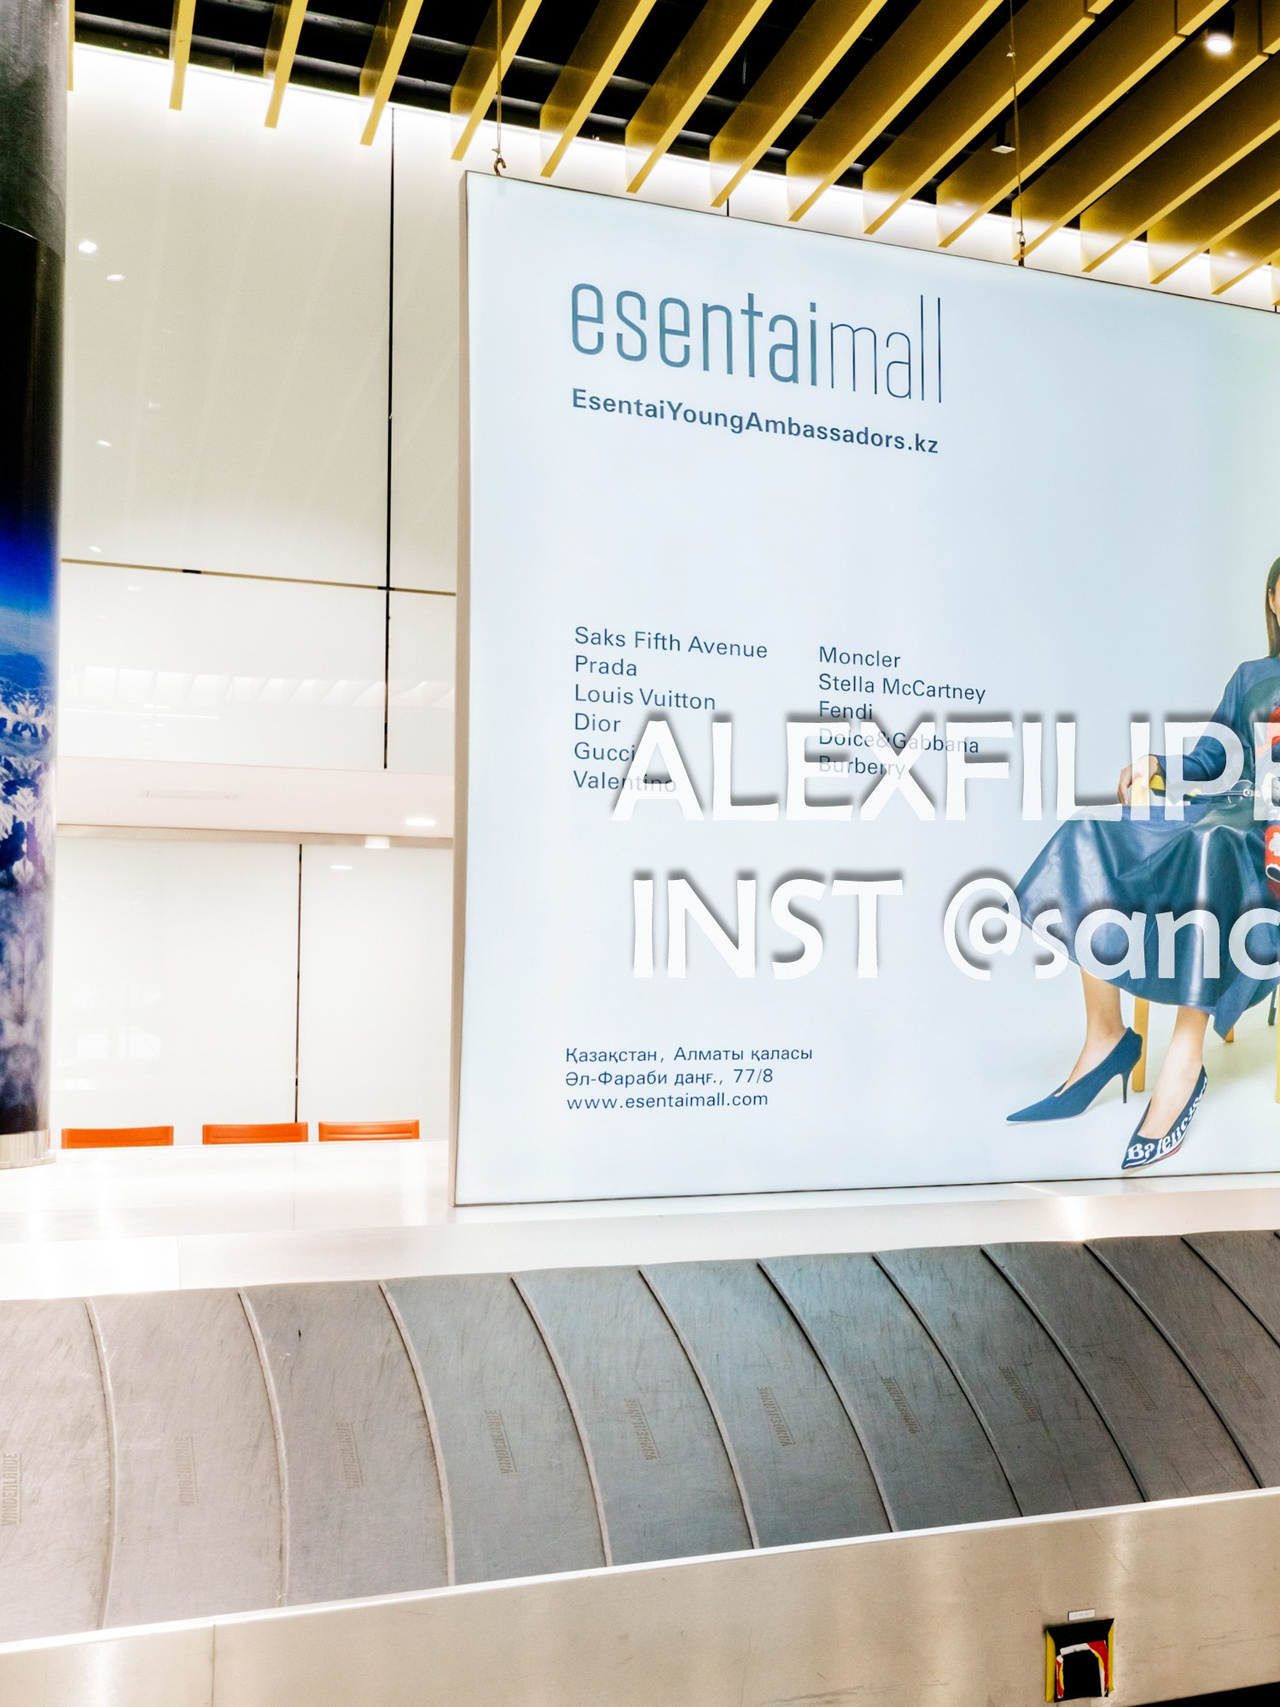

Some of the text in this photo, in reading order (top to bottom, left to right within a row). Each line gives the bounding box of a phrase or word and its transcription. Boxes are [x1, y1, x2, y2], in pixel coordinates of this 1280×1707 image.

[572, 283, 942, 404] esentaimall
[572, 388, 940, 454] EsentaiYoungAmbassadors.kz
[575, 626, 768, 658] Saks Fifth Avenue
[575, 655, 637, 676] Prada
[819, 646, 901, 668] Moncler
[575, 684, 716, 711] Louis Vuitton
[819, 673, 986, 704] Stella McCartney
[819, 700, 873, 720] Fendi
[575, 713, 621, 732] Dior
[819, 728, 979, 753] Dolce&Gabbana
[574, 742, 635, 762] Gucci
[573, 770, 677, 792] Valentino
[566, 1046, 812, 1064] Қазақстан, Алматы қаласы
[566, 1070, 667, 1088] Әл-Фараби
[734, 1068, 773, 1084] 77/8
[567, 1092, 768, 1110] www.esentaimall.com
